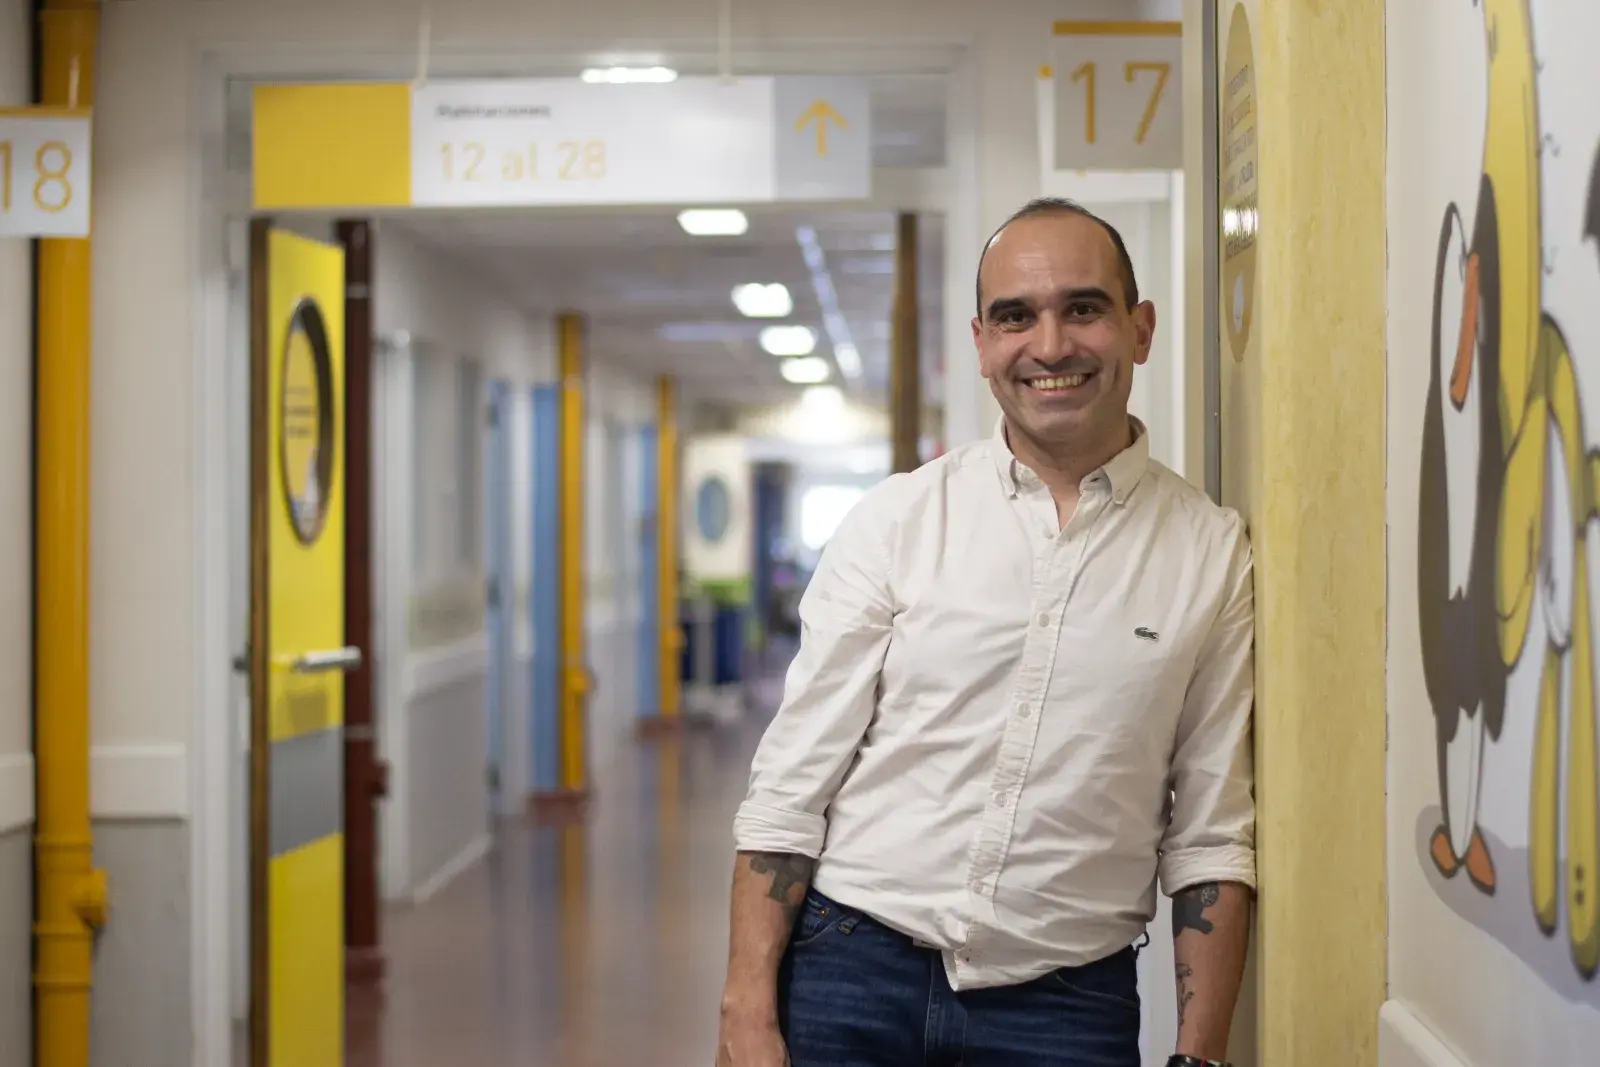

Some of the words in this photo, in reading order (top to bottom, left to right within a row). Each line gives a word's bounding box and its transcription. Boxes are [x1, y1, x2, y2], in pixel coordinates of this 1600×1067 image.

[1070, 61, 1171, 145] 17
[0, 140, 72, 213] 18
[440, 140, 486, 182] 12
[501, 140, 539, 182] al
[556, 139, 607, 182] 28
